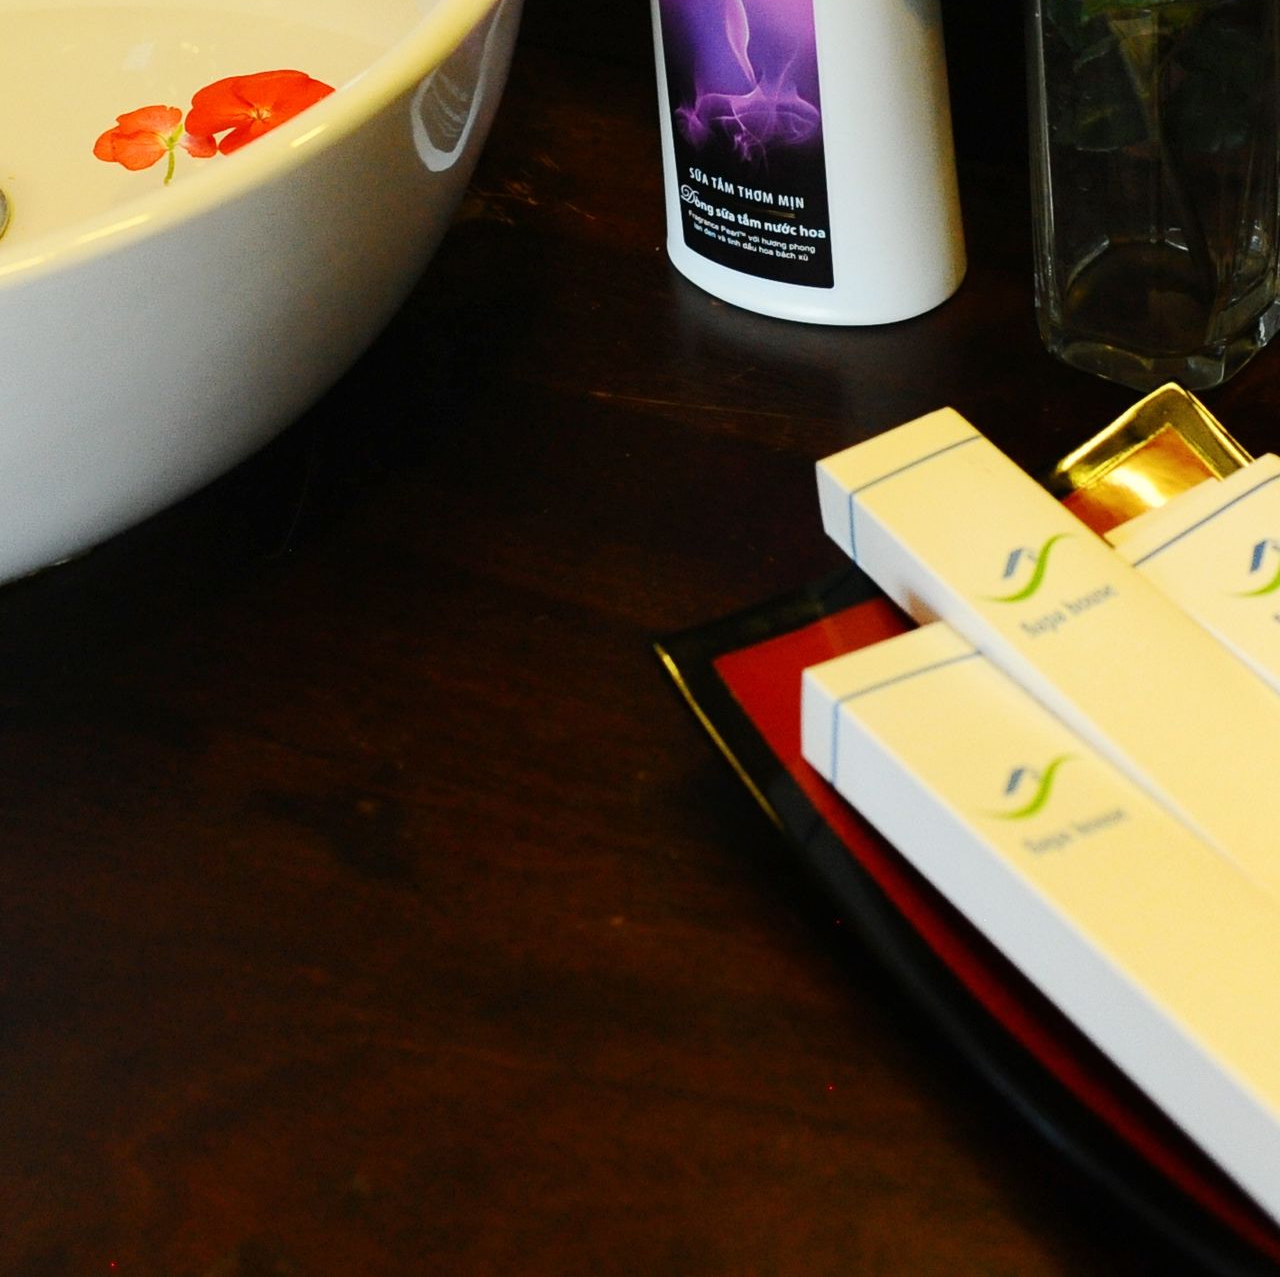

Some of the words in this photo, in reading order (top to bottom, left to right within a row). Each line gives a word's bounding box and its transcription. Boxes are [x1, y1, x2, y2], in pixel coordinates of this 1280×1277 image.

[680, 183, 715, 217] Dòng
[715, 207, 736, 223] sữa
[737, 212, 762, 230] tắm
[764, 220, 798, 237] nước
[799, 225, 827, 240] hoa
[710, 176, 735, 195] TẮM
[737, 185, 774, 205] THƠM
[777, 194, 806, 211] MỊN
